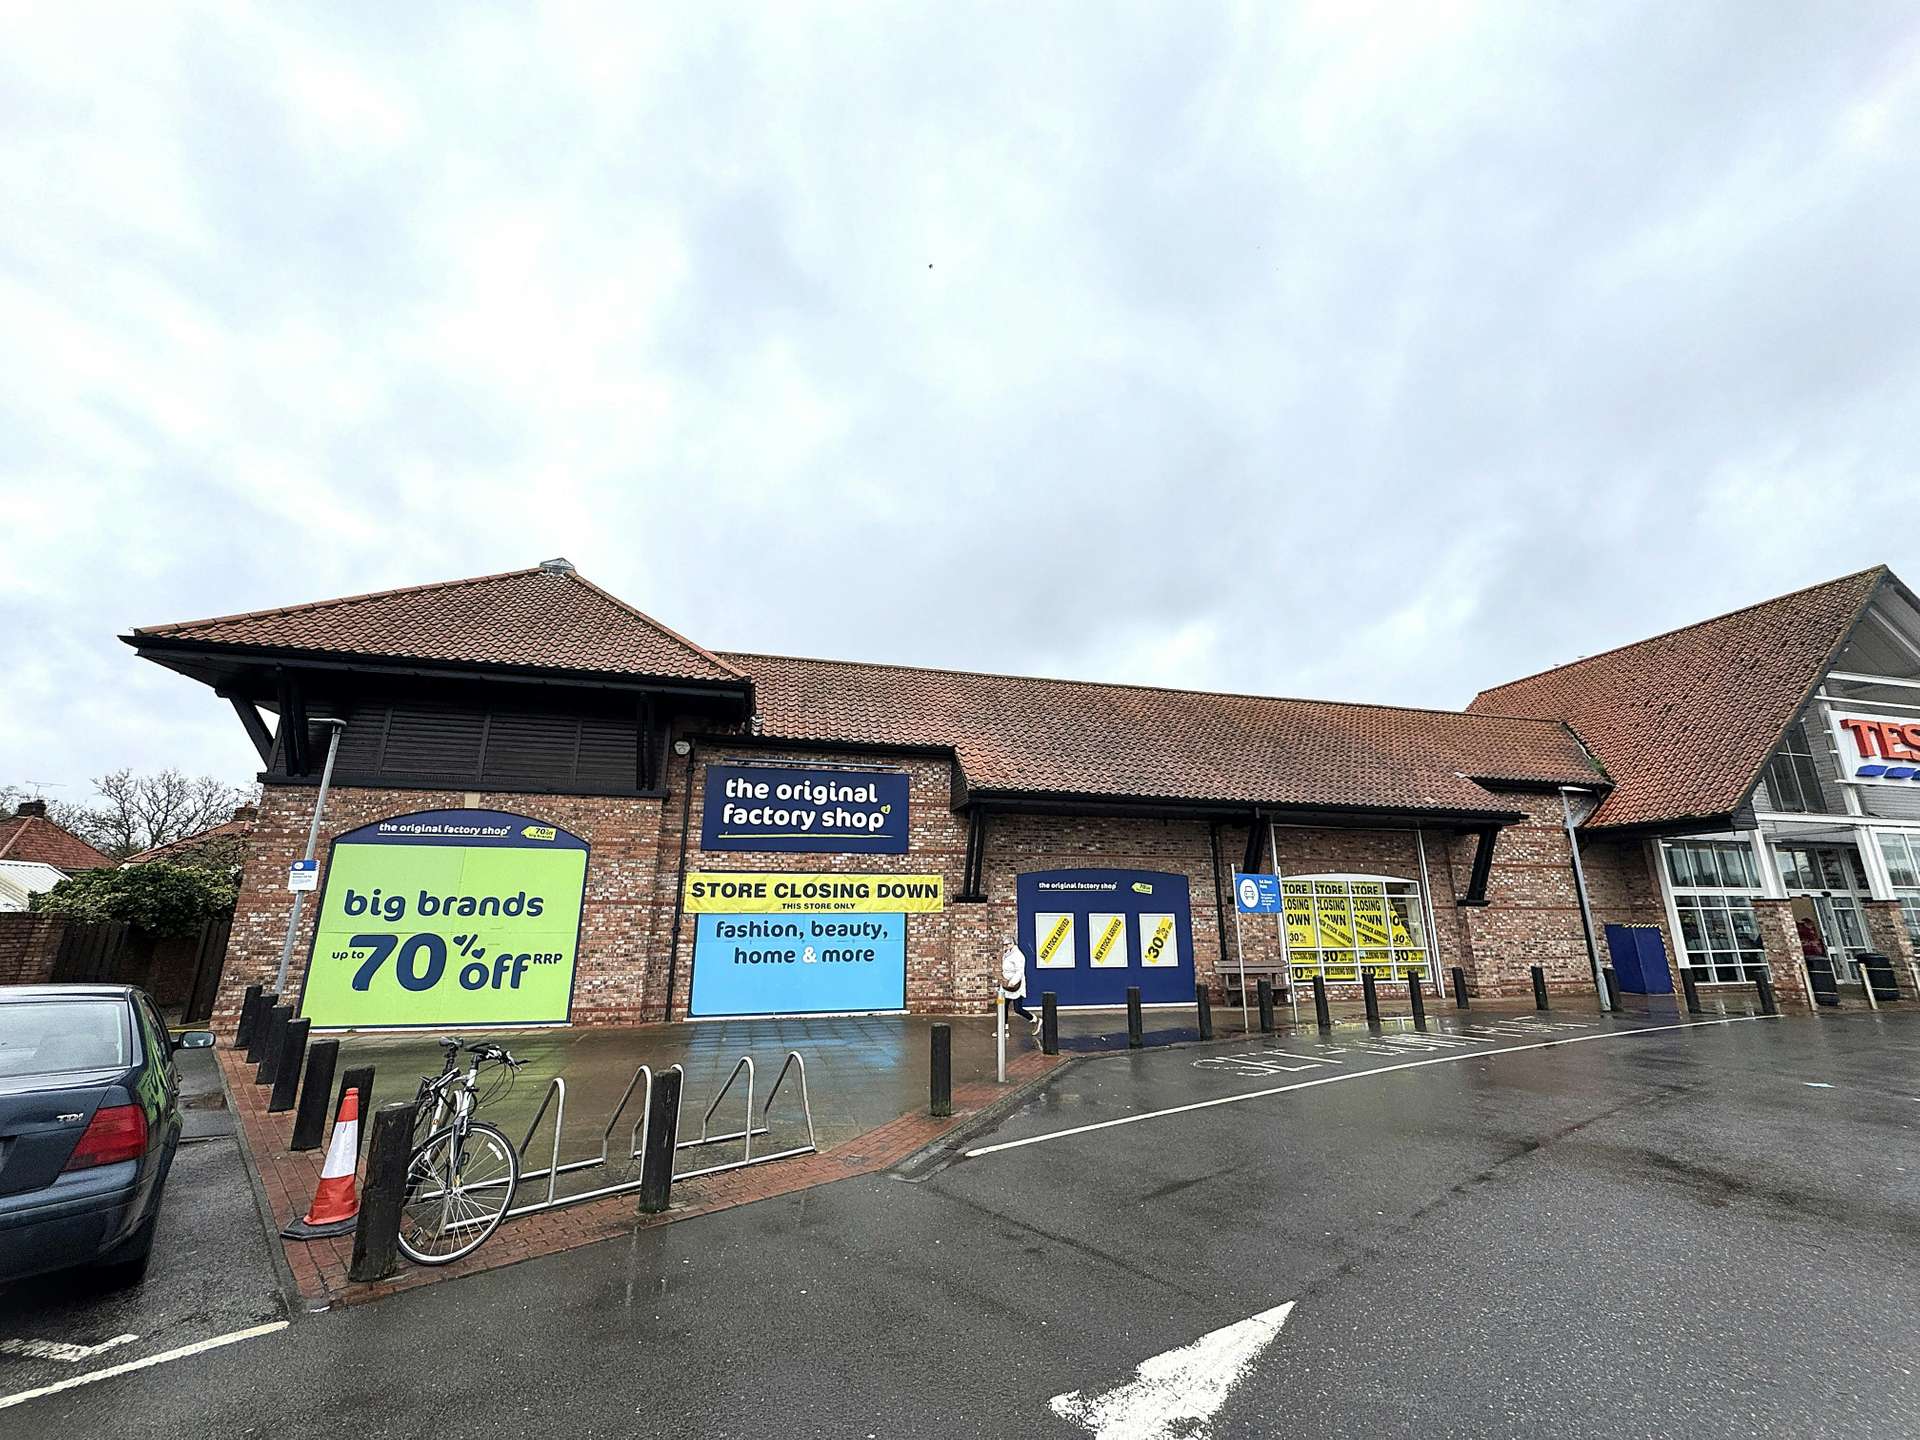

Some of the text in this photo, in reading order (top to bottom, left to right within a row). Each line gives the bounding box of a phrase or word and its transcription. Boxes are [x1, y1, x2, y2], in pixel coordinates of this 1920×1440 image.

[725, 778, 878, 805] the original
[723, 803, 884, 832] factory shop
[379, 823, 508, 836] the original factory shop
[691, 882, 938, 899] STORE CLOSING DOWN
[1051, 881, 1077, 890] original
[1077, 882, 1100, 890] factory
[344, 889, 544, 922] big brands
[1287, 914, 1310, 926] OWN
[716, 921, 888, 939] fashion, beauty,
[734, 946, 875, 964] home & more
[332, 951, 348, 960] up
[351, 950, 365, 959] to
[459, 953, 532, 990] off
[533, 954, 563, 964] RRP
